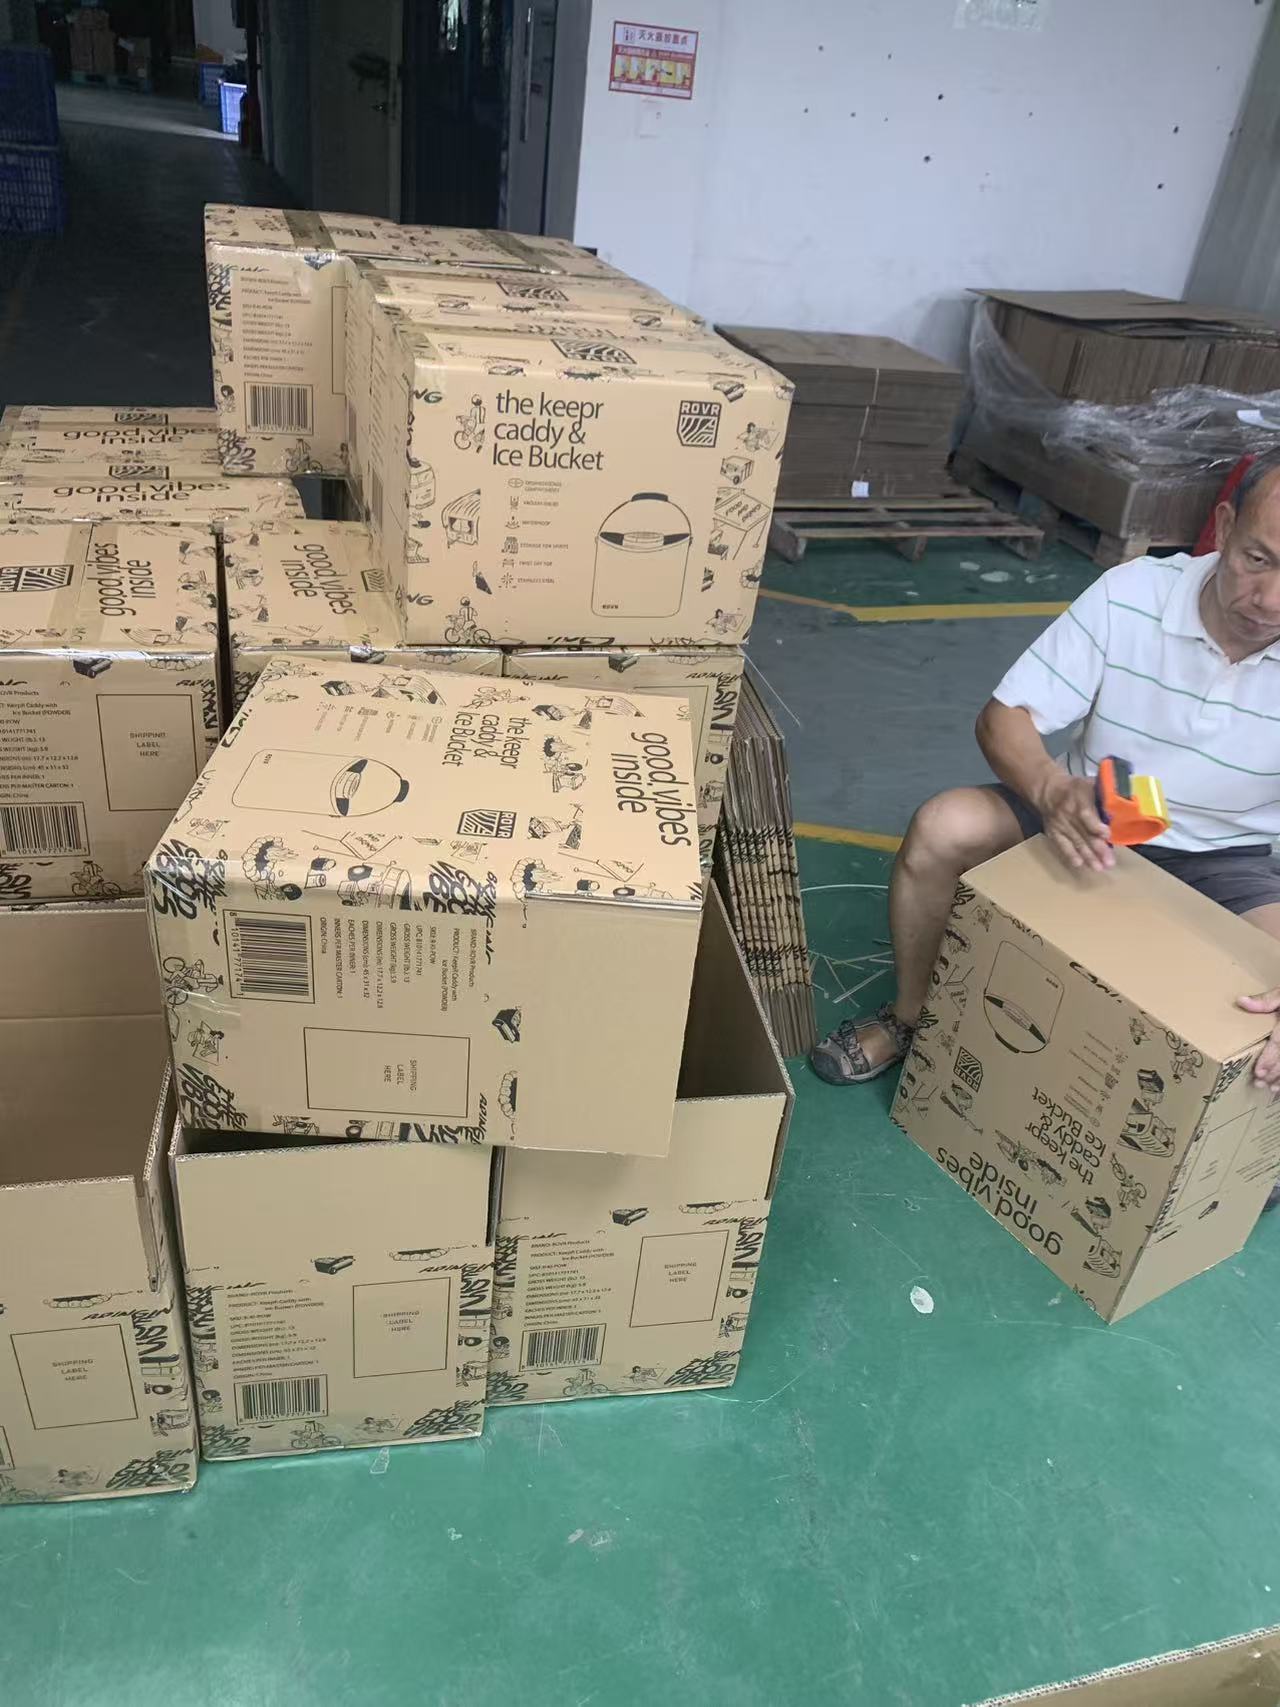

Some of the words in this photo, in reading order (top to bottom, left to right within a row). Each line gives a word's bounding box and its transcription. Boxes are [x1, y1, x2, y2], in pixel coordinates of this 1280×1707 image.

[496, 389, 534, 415] the
[540, 392, 604, 425] keepr
[681, 402, 720, 415] ROVR
[64, 428, 140, 440] good
[149, 428, 221, 436] vibes
[101, 434, 182, 444] inside
[494, 418, 564, 449] caddy
[568, 421, 586, 444] &
[493, 443, 523, 467] Ice
[529, 445, 604, 471] Bucket
[54, 483, 140, 497] good
[150, 482, 230, 492] vibes
[96, 490, 190, 502] inside
[86, 543, 120, 576] vibes
[294, 544, 348, 577] good
[117, 559, 156, 598] inside
[280, 560, 324, 597] inside
[88, 577, 136, 616] good
[320, 580, 357, 614] vibes
[454, 712, 480, 726] Ice
[470, 714, 504, 748] caddy
[507, 718, 532, 735] the
[442, 727, 475, 767] Bucket
[474, 748, 498, 758] &
[497, 736, 530, 769] keepr
[631, 732, 689, 784] good
[611, 753, 658, 813] inside
[498, 812, 516, 838] ROVR
[652, 790, 696, 846] vibes
[396, 1064, 404, 1085] LABEL
[1032, 1086, 1083, 1138] Bucket
[1040, 1113, 1053, 1131] &
[1025, 1122, 1067, 1165] keepr
[1053, 1125, 1100, 1168] caddy
[1084, 1130, 1106, 1158] Ice
[936, 1147, 990, 1203] vibes
[970, 1152, 1038, 1220] inside
[1069, 1157, 1094, 1185] the
[994, 1197, 1063, 1255] good
